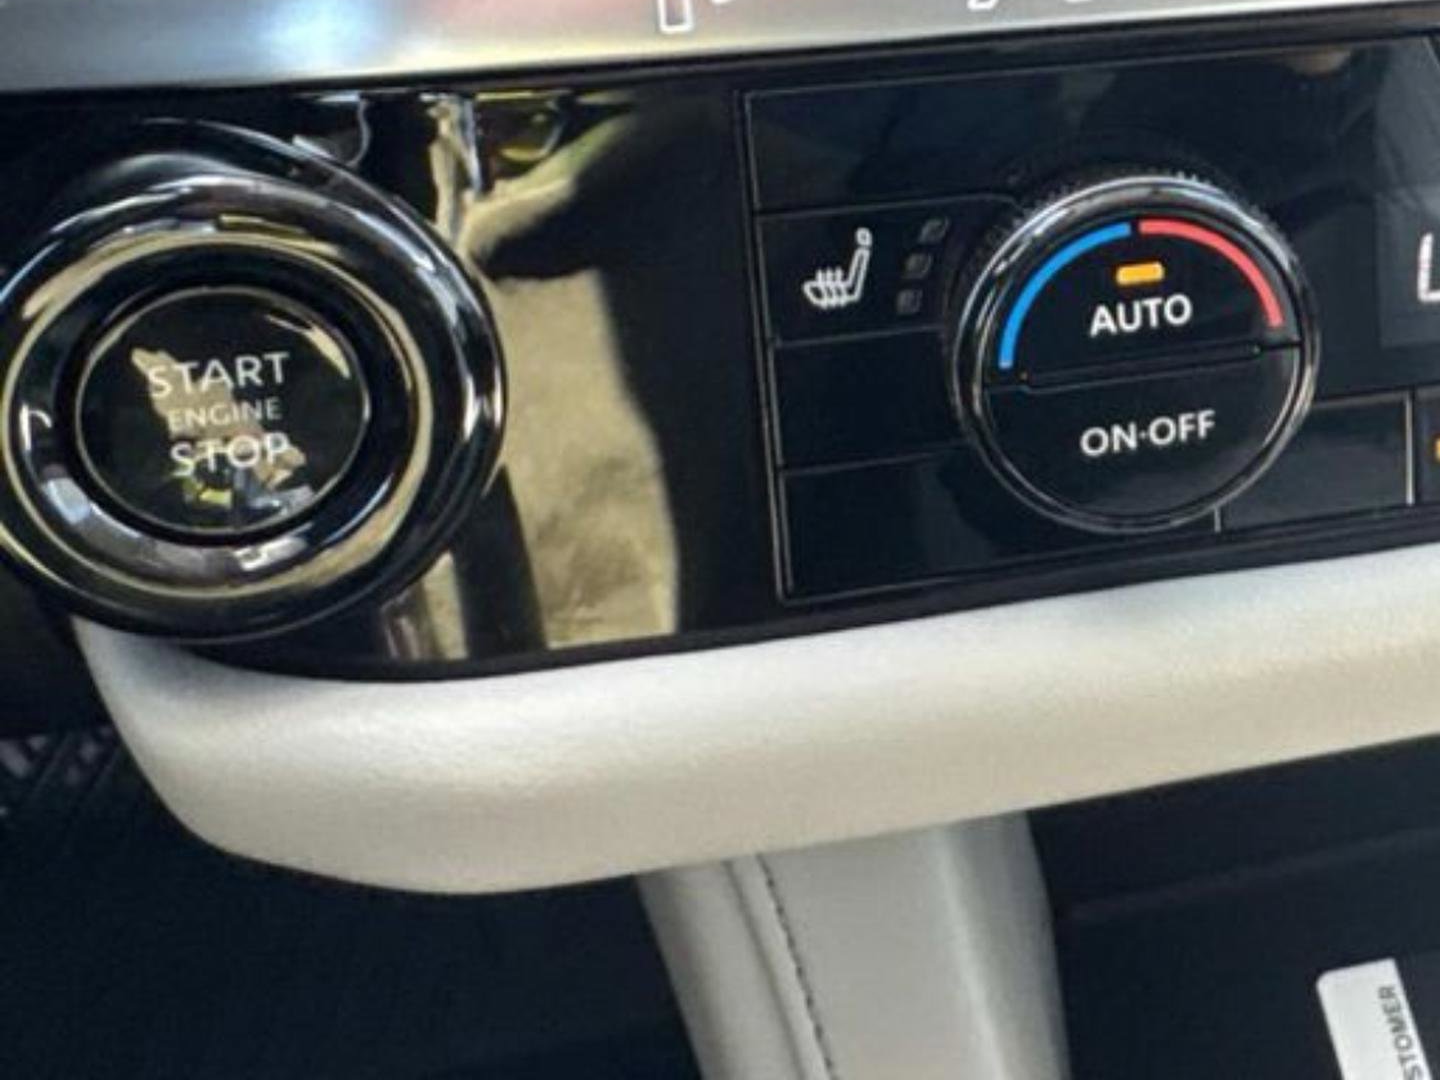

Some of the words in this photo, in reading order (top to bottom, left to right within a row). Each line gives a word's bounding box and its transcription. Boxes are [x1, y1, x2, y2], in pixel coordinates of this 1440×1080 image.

[1089, 293, 1194, 338] AUTO
[148, 350, 290, 398] START
[167, 396, 283, 433] ENGINE
[170, 431, 290, 476] STOP
